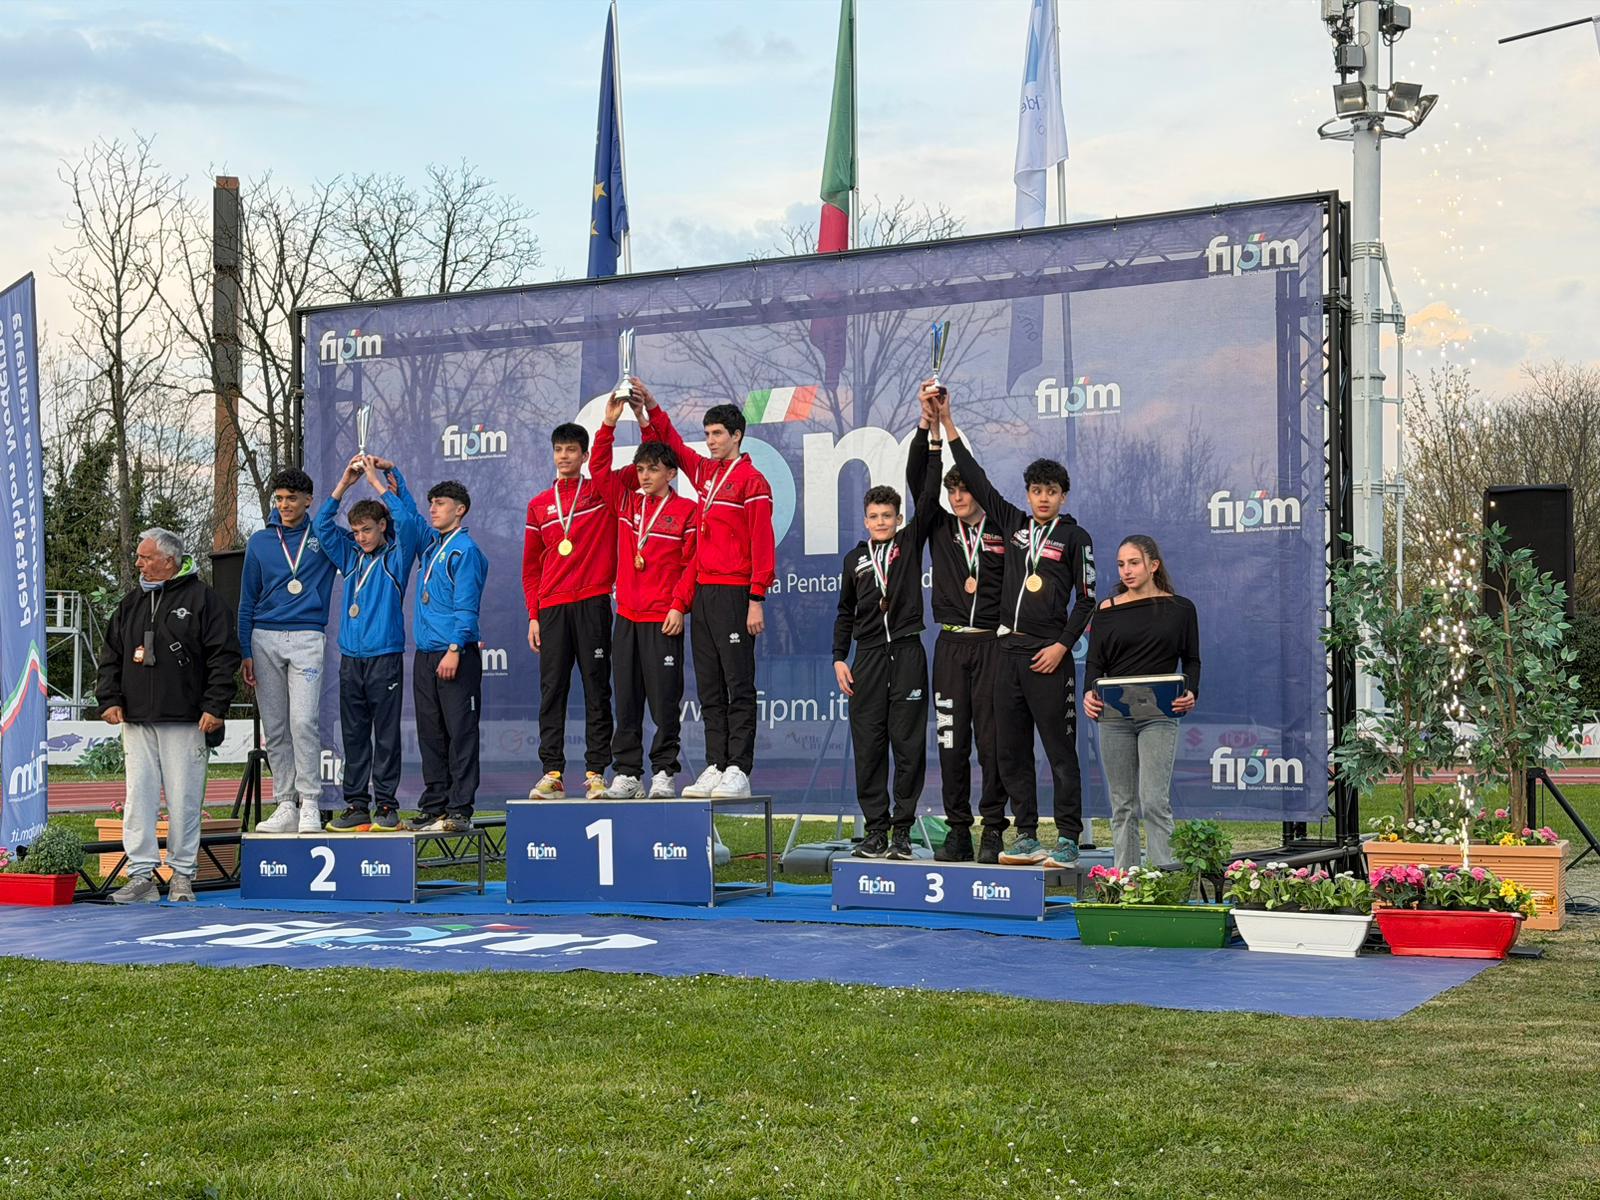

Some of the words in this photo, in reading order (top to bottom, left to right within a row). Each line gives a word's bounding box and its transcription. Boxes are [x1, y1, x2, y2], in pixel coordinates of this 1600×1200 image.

[1205, 233, 1299, 276] fipm
[320, 330, 382, 364] fipm
[1035, 377, 1120, 417] fipm
[442, 425, 507, 460] fipm
[1208, 490, 1300, 532] fipm
[787, 573, 842, 593] Pentat
[935, 692, 954, 749] JAT
[1209, 746, 1303, 790] fipm
[527, 842, 557, 859] fipm
[585, 819, 614, 886] 1
[653, 842, 687, 859] fipm
[260, 860, 288, 876] fipm
[310, 846, 337, 892] 2
[361, 860, 391, 876] fipm
[858, 875, 896, 894] fipm
[924, 873, 945, 903] 3
[971, 880, 1011, 900] fipm
